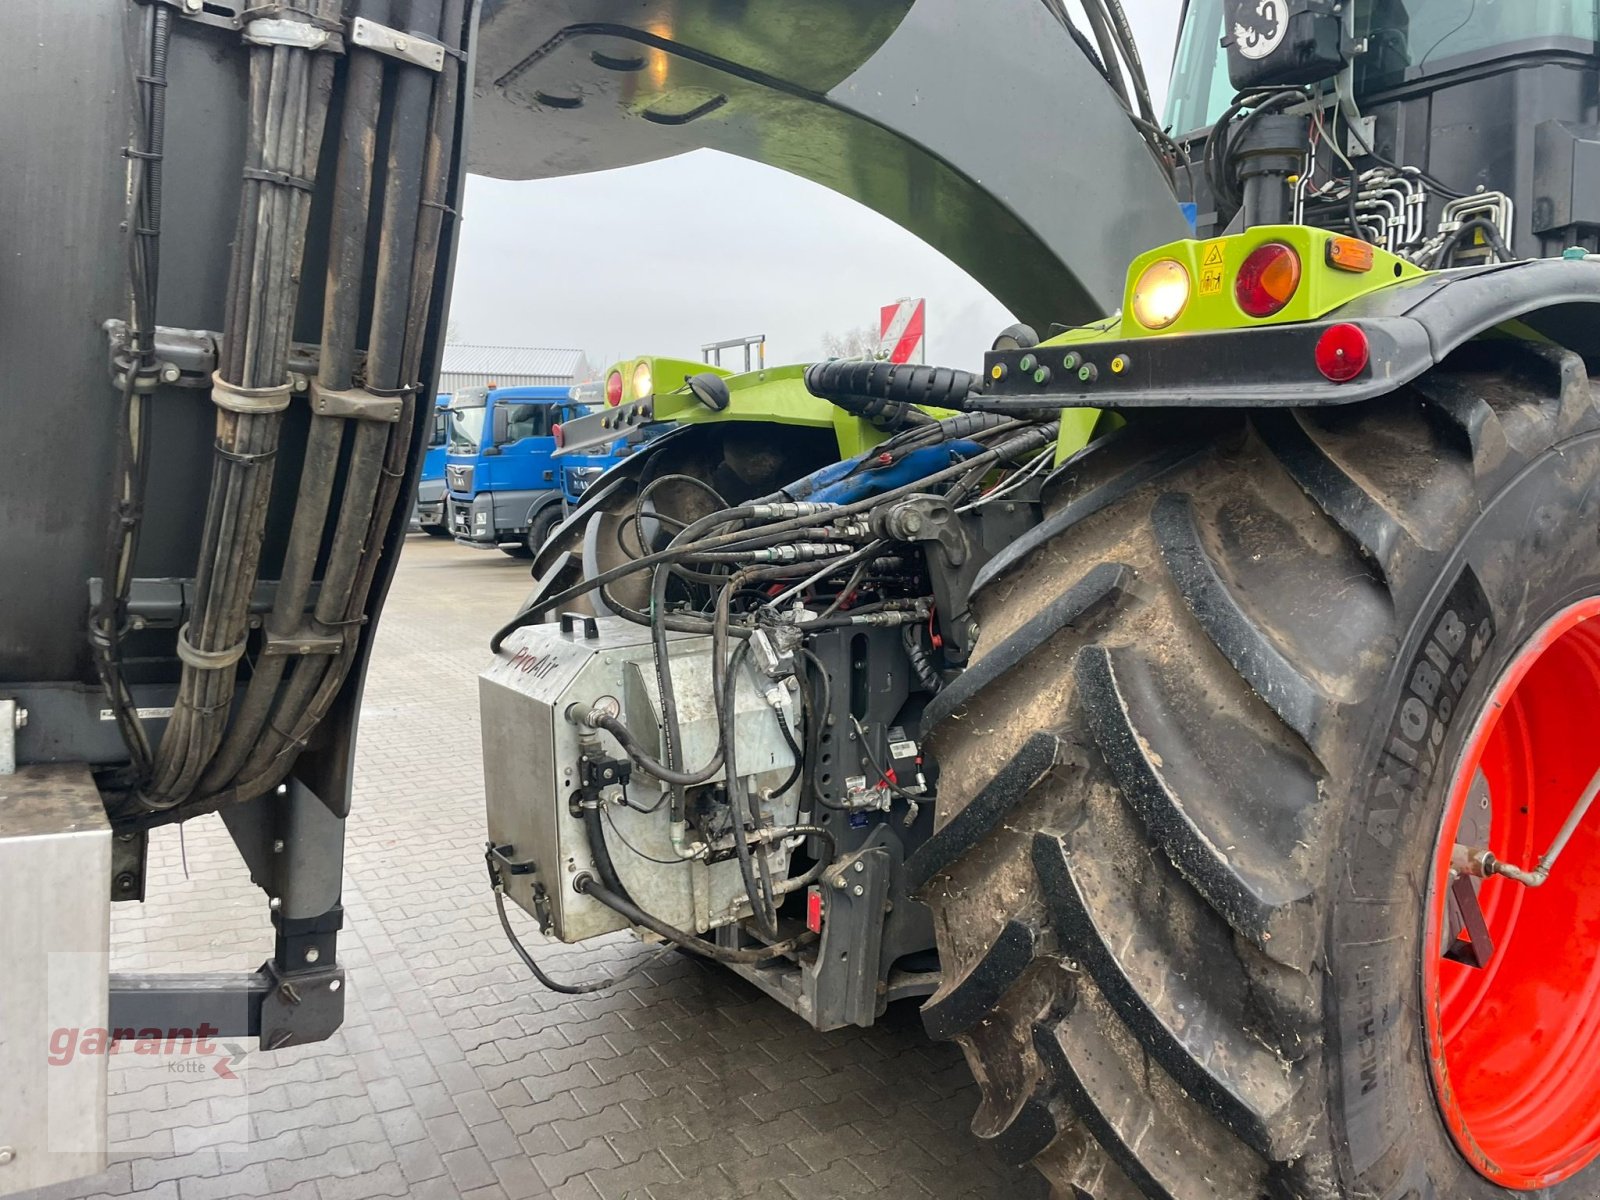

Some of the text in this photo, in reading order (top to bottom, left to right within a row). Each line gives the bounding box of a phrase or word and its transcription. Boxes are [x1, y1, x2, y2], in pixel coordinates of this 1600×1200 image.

[506, 646, 559, 680] ProAir
[1450, 663, 1468, 696] R
[1471, 617, 1492, 663] 42
[1366, 610, 1467, 849] AXIOBIB
